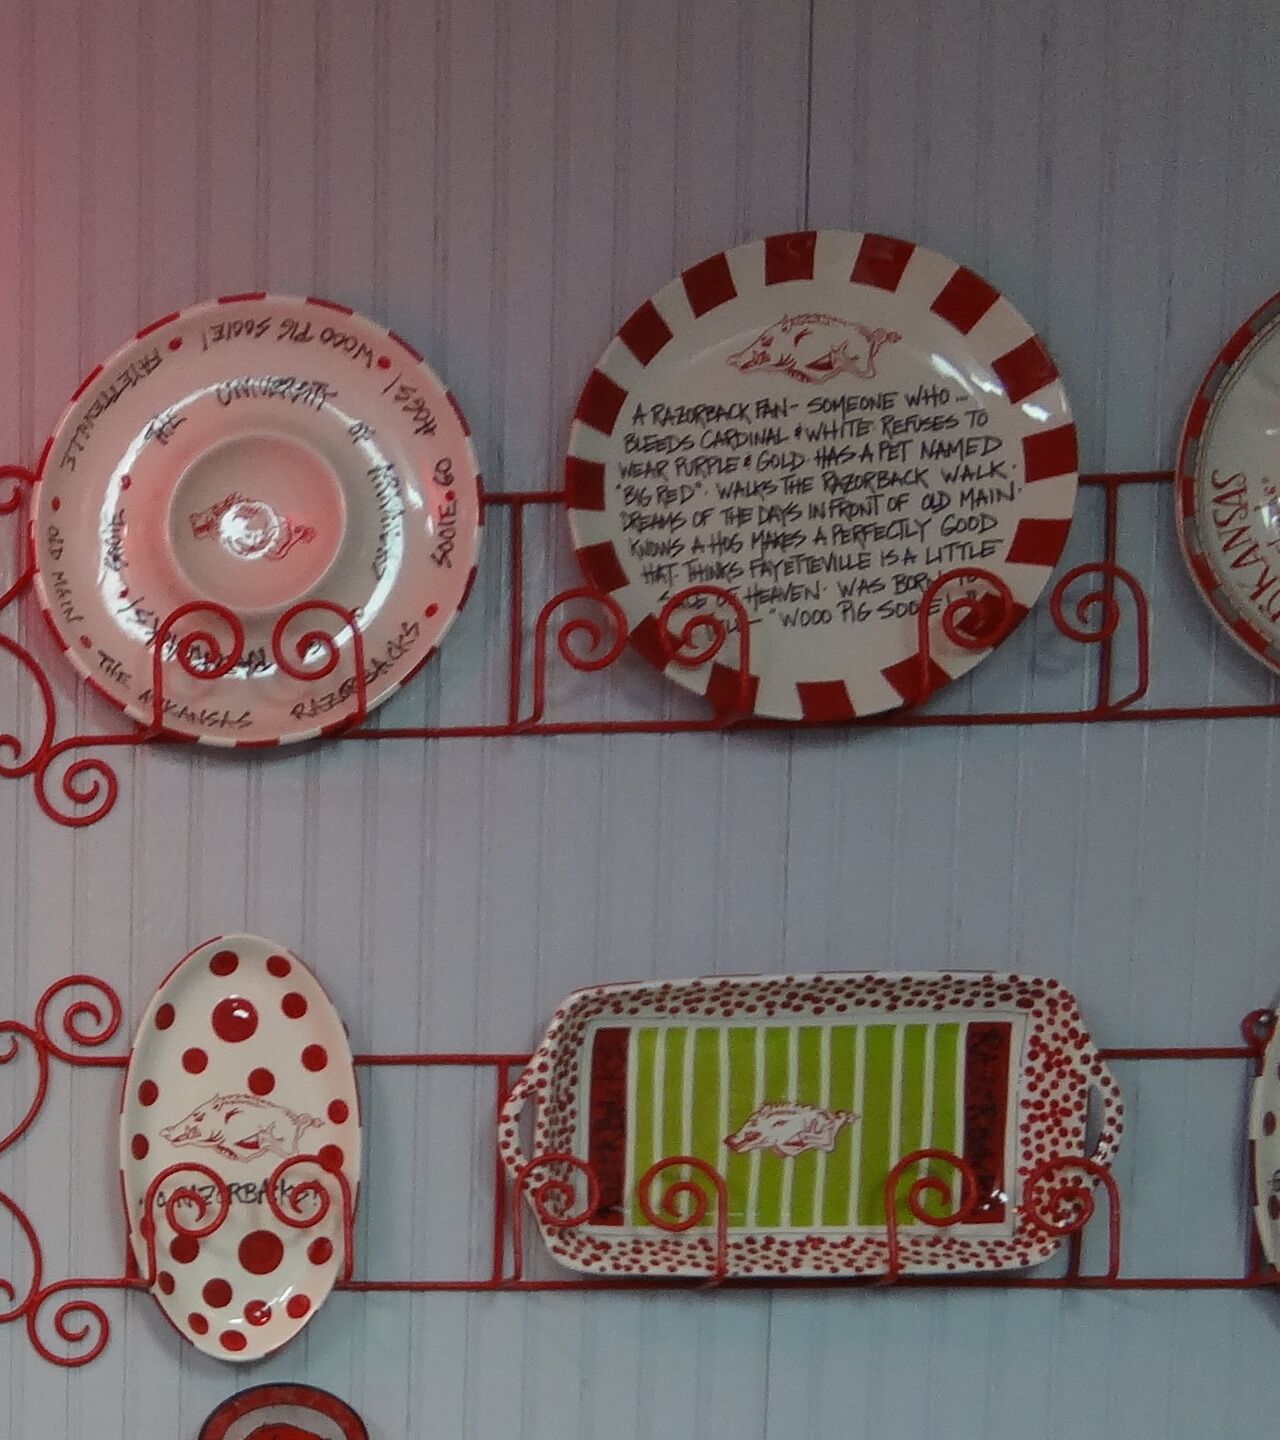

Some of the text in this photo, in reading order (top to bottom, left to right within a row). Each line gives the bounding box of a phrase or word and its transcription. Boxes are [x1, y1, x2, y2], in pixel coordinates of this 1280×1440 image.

[277, 318, 313, 344] PIG
[320, 326, 374, 369] WOOO
[631, 402, 646, 425] A
[651, 402, 752, 428] RAZORBACK
[807, 391, 899, 419] SOMEONE
[623, 432, 695, 455] BLEEDS
[700, 426, 789, 451] CARDINAL
[880, 413, 960, 439] REFUSES
[964, 407, 990, 428] TO
[433, 458, 454, 487] GO
[618, 459, 670, 481] WEAR
[675, 455, 740, 480] PURPLE
[814, 445, 856, 470] HAS
[859, 441, 874, 463] A
[878, 438, 913, 463] PET
[920, 435, 1003, 461] NAMED
[716, 479, 778, 502] WALKS
[780, 473, 815, 496] THE
[822, 465, 929, 496] RAZORBACK
[620, 510, 687, 535] DREAMS
[692, 506, 715, 528] OF
[719, 504, 753, 529] THE
[758, 501, 802, 527] DAYS
[807, 499, 826, 520] IN
[828, 493, 884, 523] FRONT
[887, 492, 910, 513] OF
[921, 491, 952, 515] OLD
[48, 524, 65, 562] OLD
[629, 513, 999, 559] KNOWS A HOG MAKES A PERFECTLY GOOD
[682, 557, 745, 584] THINKS
[749, 551, 871, 586] FAYETTEVILLE
[880, 549, 899, 567] IS
[903, 546, 918, 566] A
[926, 538, 1004, 566] LITTLE
[51, 570, 84, 624] MAIN
[837, 577, 886, 598] WAS
[893, 570, 943, 595] BOR
[837, 600, 871, 625] PIG
[290, 621, 420, 721] RAZORACKS
[139, 688, 253, 730] AKANSAS
